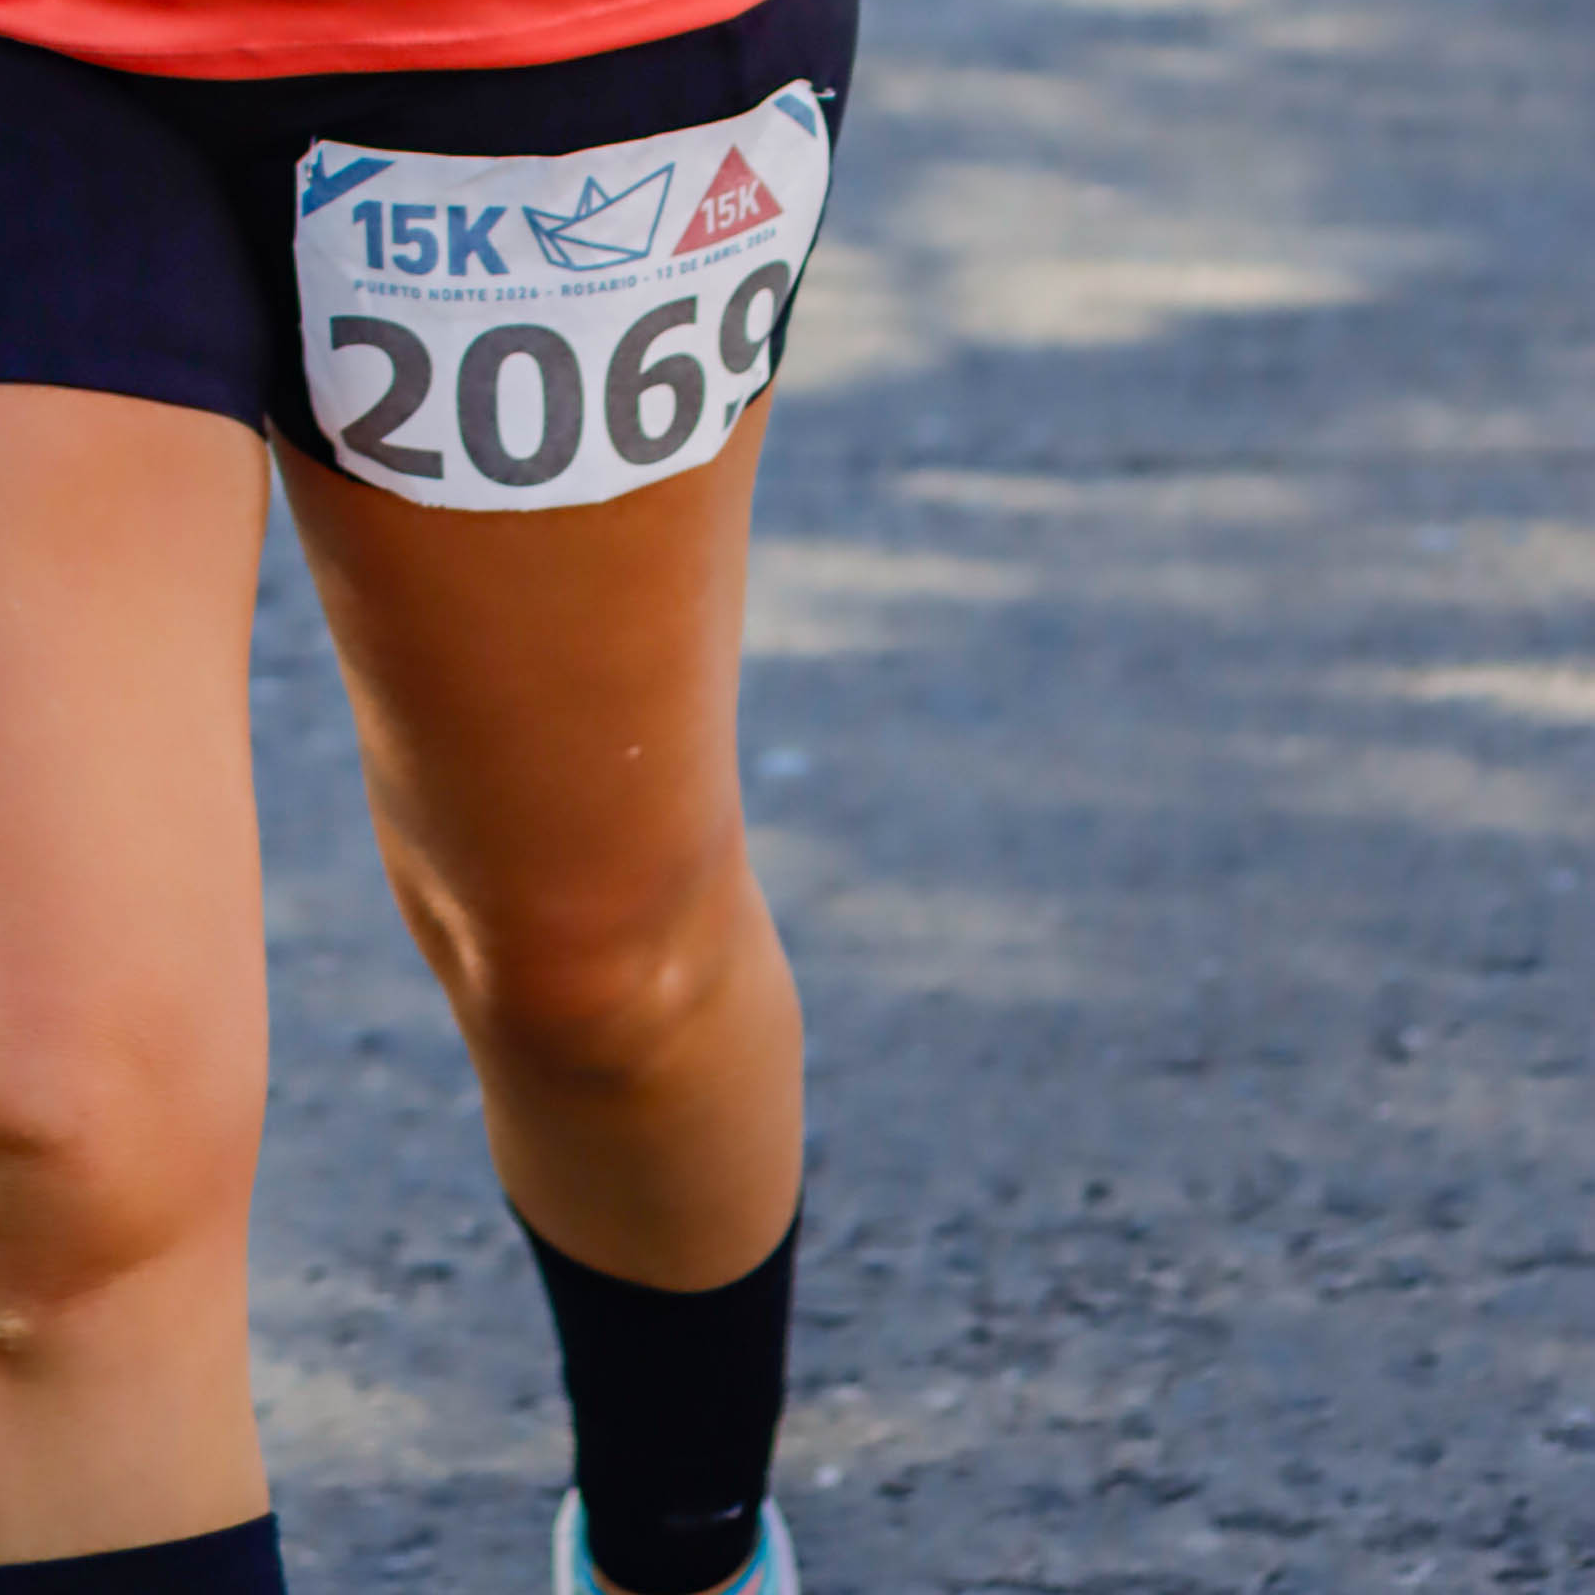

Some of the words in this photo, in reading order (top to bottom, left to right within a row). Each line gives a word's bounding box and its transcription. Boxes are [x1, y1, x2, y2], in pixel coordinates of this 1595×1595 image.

[352, 200, 510, 277] 15K
[702, 178, 762, 235] 15K
[353, 280, 422, 300] PUERTO
[428, 288, 487, 302] NORTE
[495, 285, 539, 301] 2026
[560, 274, 638, 297] ROSARIO
[656, 265, 673, 281] 12
[679, 258, 698, 275] DE
[703, 243, 742, 266] ABRIL
[329, 260, 792, 487] 2069
